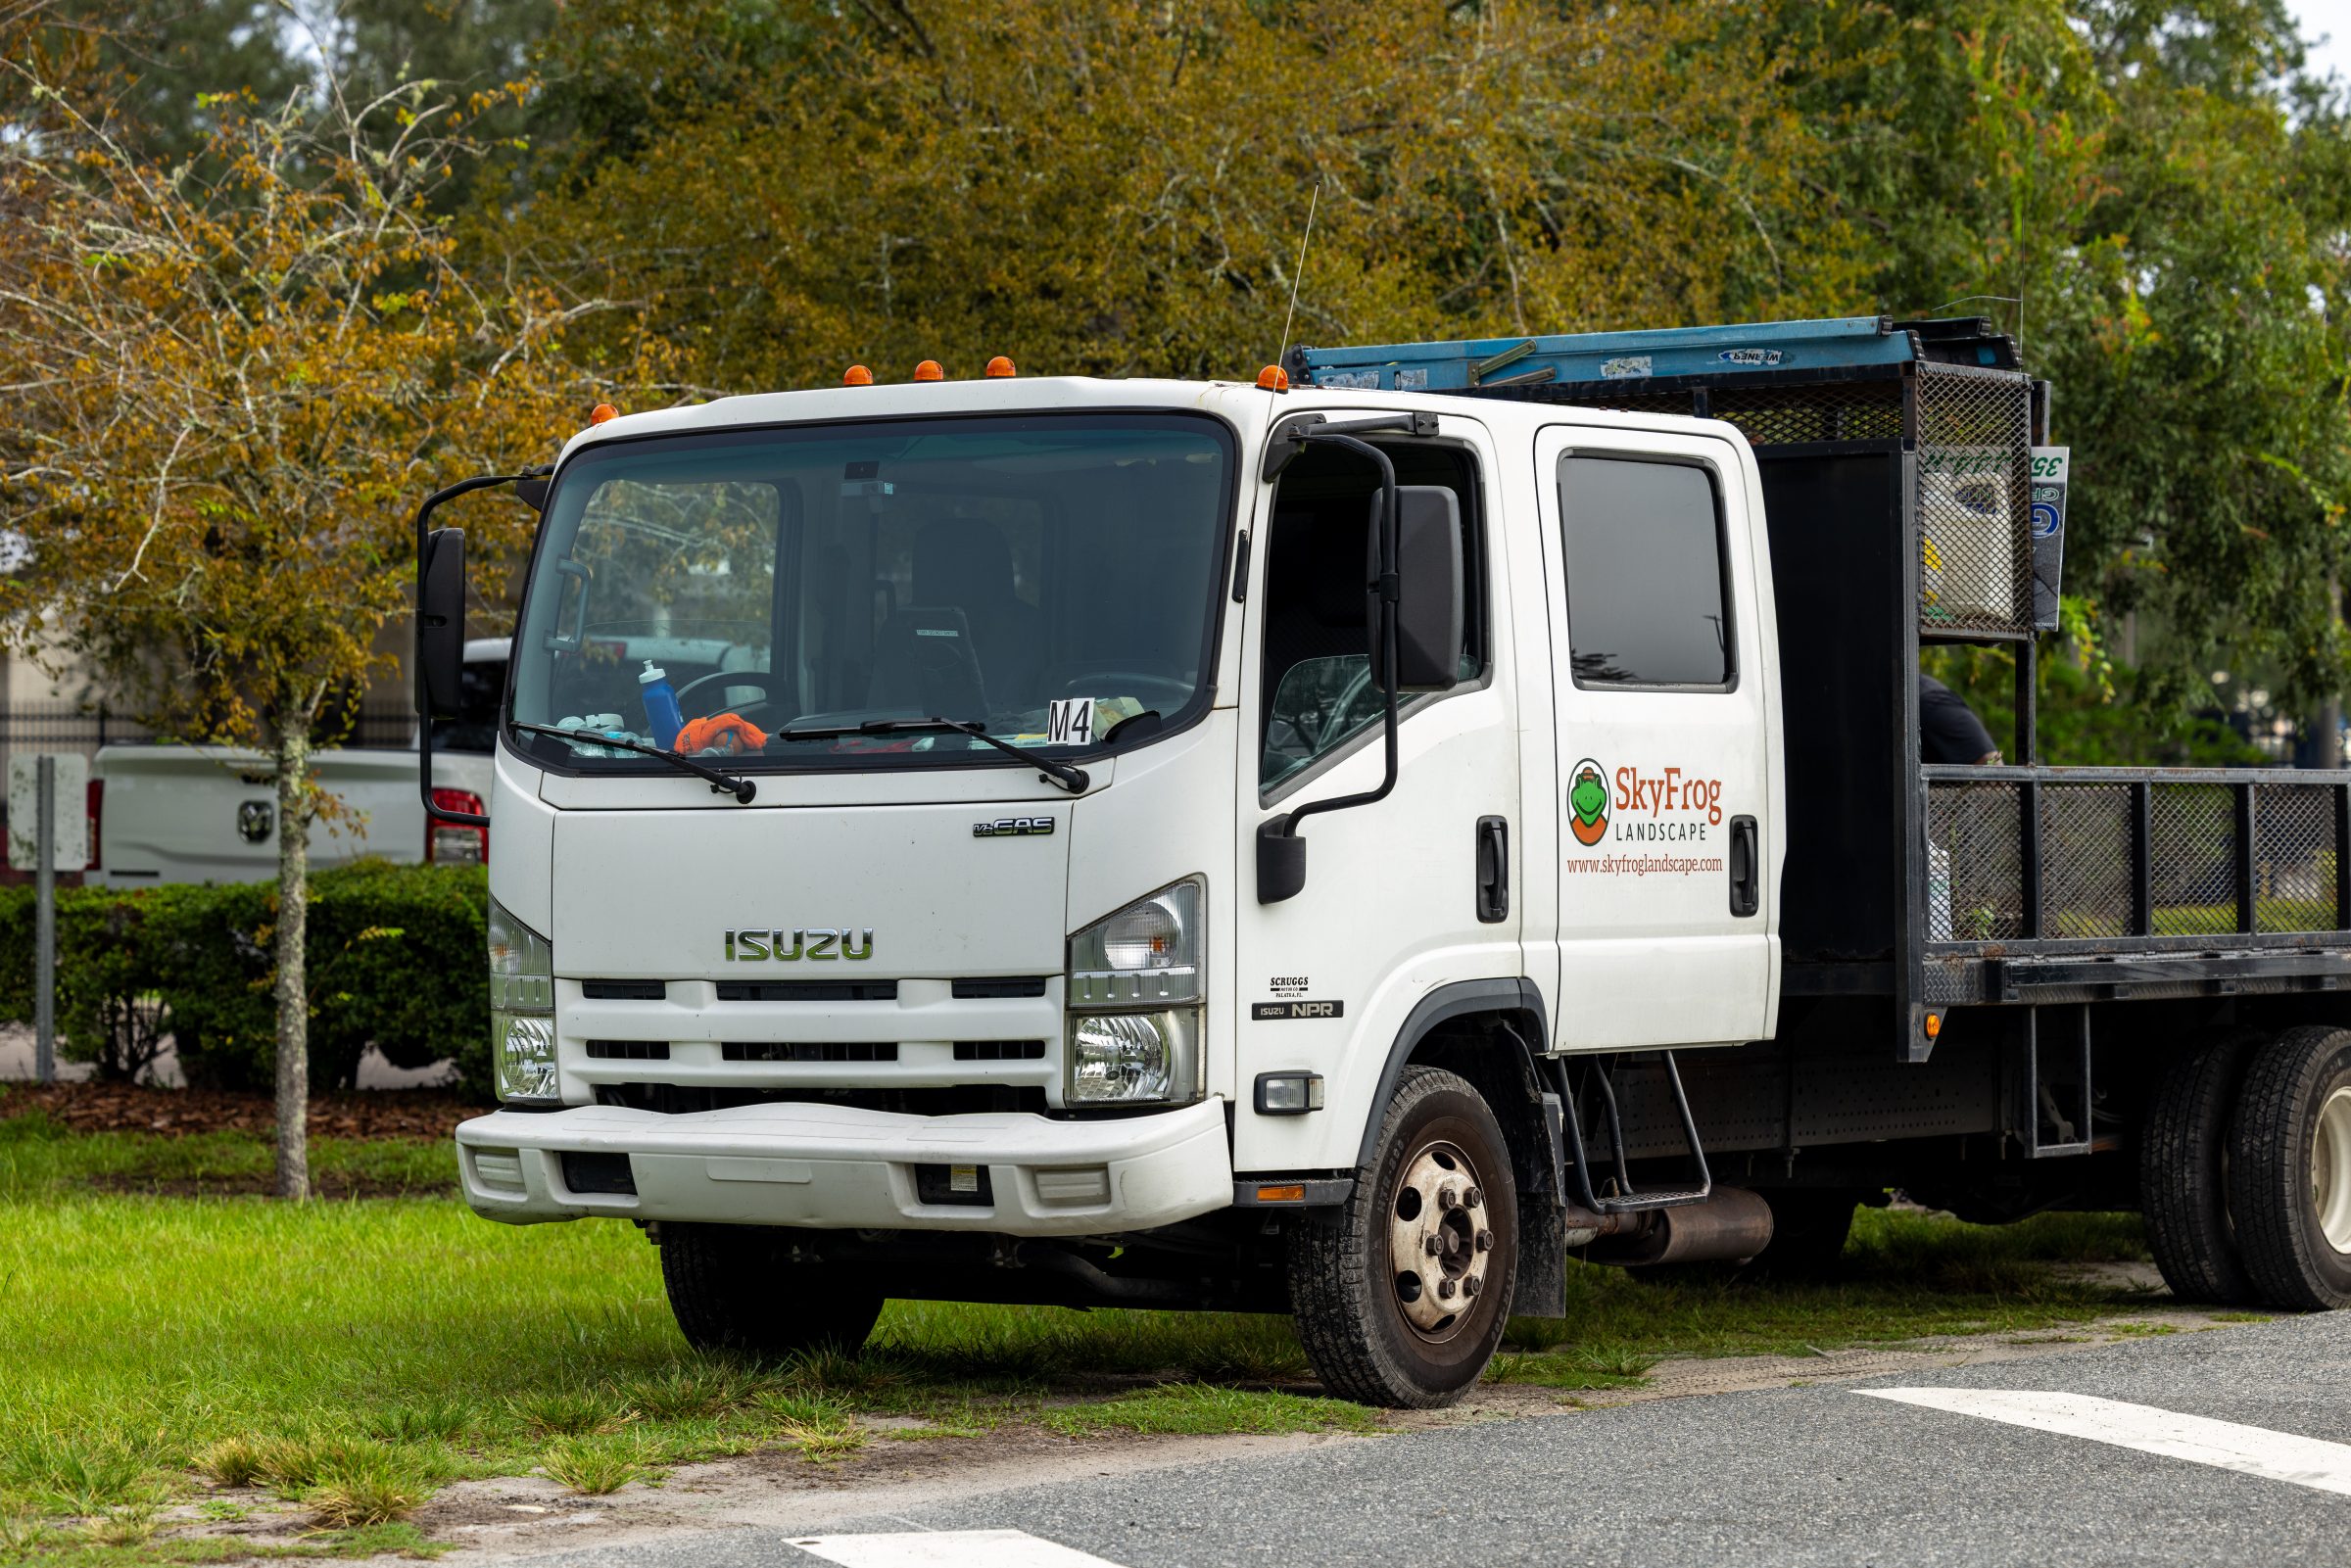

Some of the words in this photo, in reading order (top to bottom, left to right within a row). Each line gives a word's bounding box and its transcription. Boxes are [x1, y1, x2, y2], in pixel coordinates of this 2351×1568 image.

[2031, 456, 2063, 478] 35
[1048, 700, 1090, 742] M4
[1615, 766, 1722, 827] SkyFrog
[994, 817, 1053, 835] GAS
[1616, 822, 1706, 841] LANDSCAPE
[1566, 853, 1723, 877] www.skyfroglandscape.com
[725, 927, 874, 961] ISUZU
[1271, 977, 1308, 986] SCRUGGS
[1260, 1007, 1285, 1016] ISUZU
[1291, 1002, 1334, 1018] NPR
